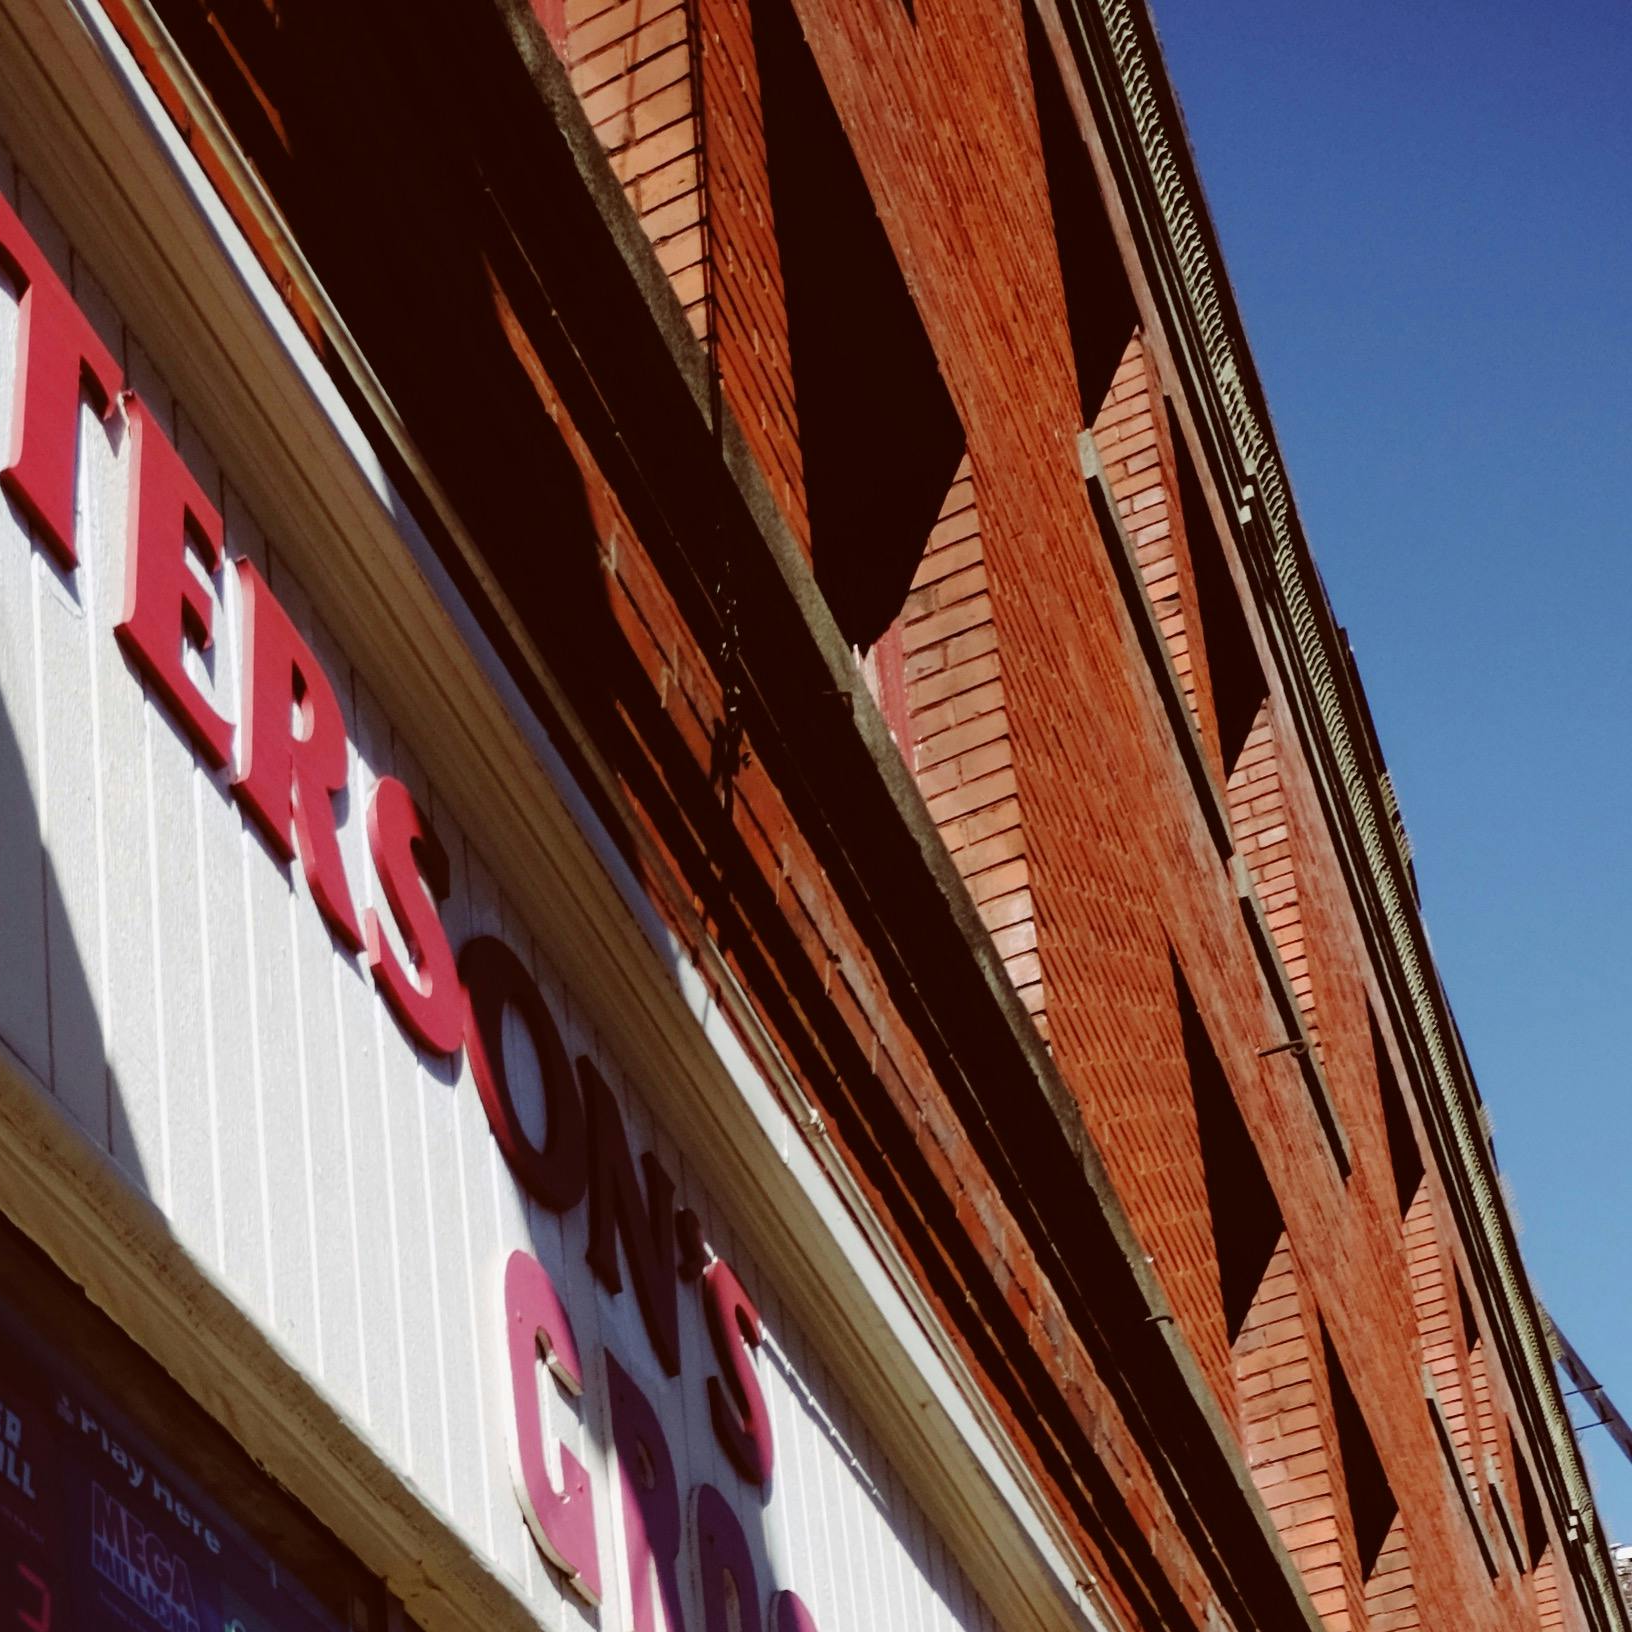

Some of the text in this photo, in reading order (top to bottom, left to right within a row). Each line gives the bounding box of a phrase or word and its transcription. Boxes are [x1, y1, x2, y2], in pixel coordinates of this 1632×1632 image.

[79, 1405, 145, 1489] Play
[151, 1473, 222, 1555] Here
[91, 1479, 197, 1617] MEGA
